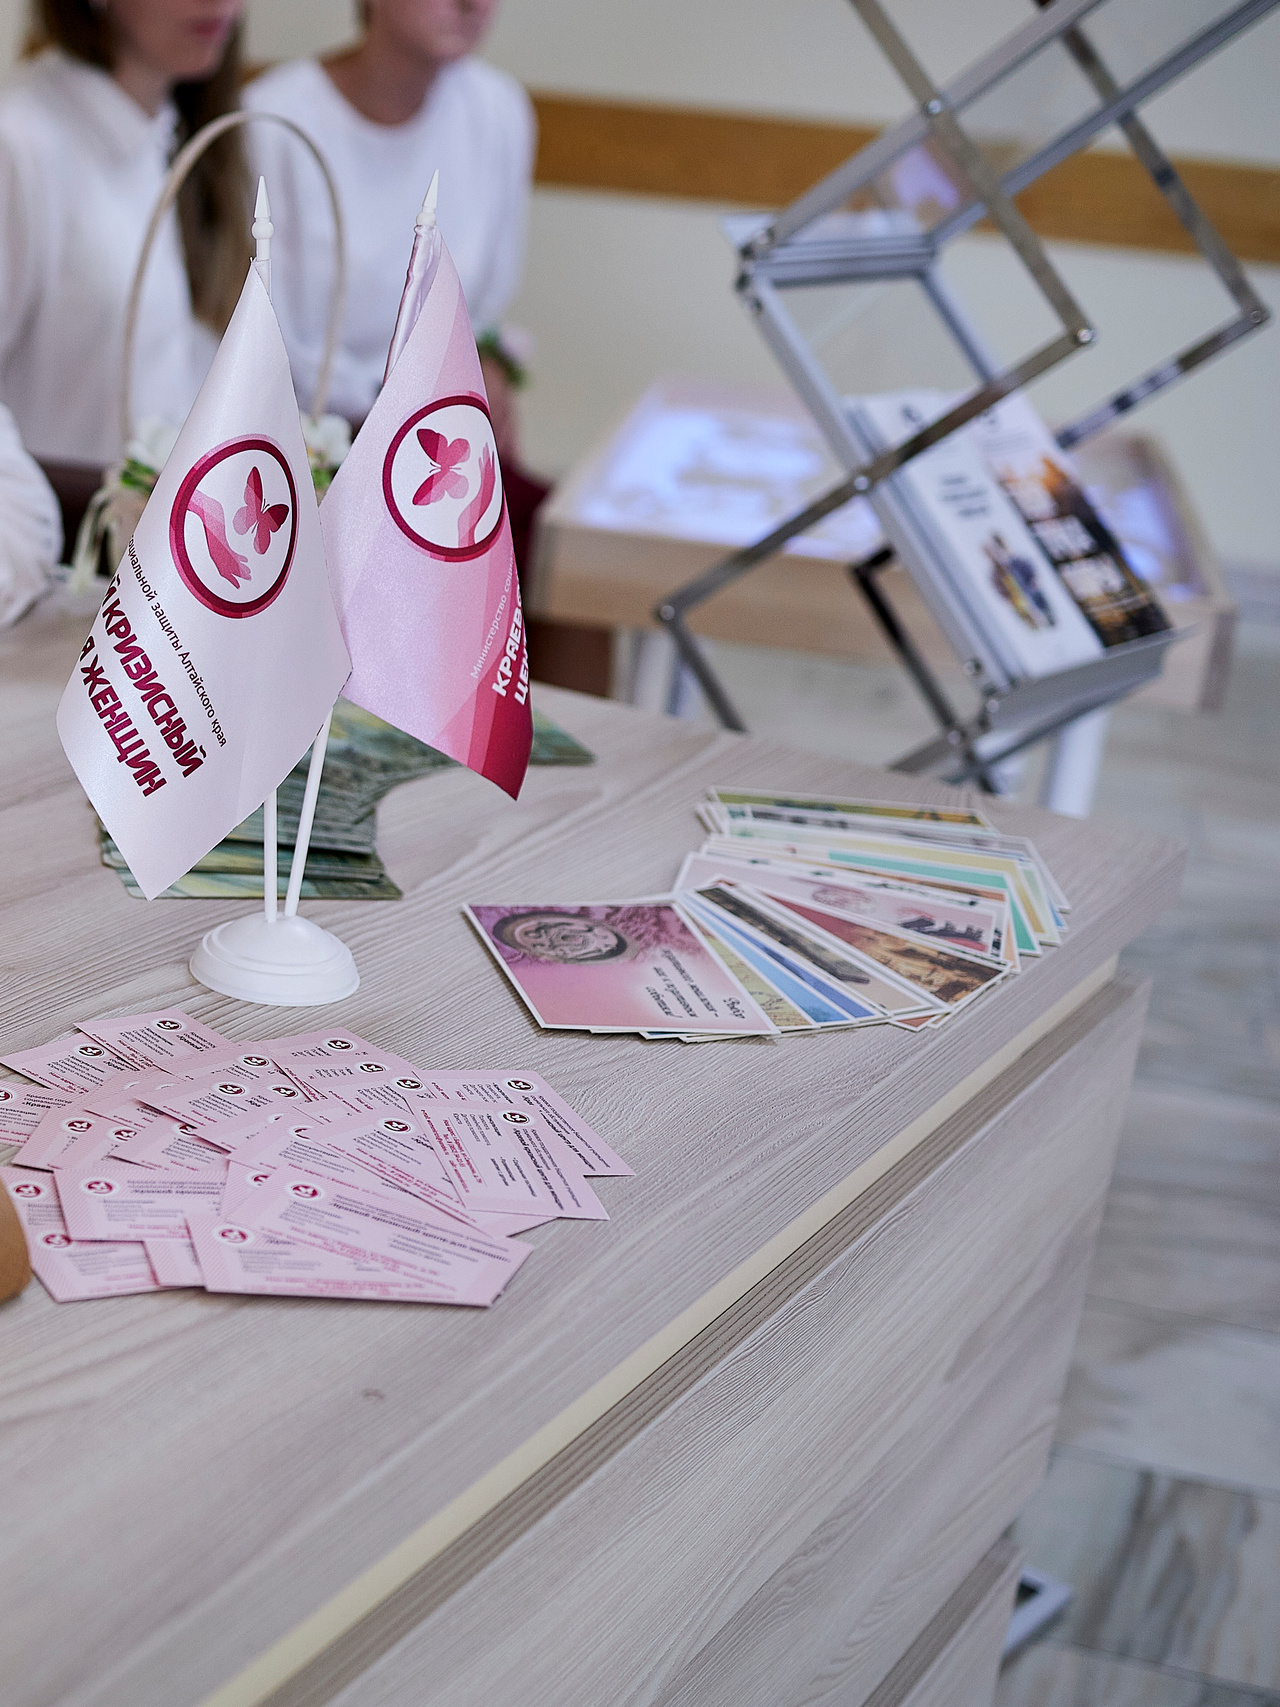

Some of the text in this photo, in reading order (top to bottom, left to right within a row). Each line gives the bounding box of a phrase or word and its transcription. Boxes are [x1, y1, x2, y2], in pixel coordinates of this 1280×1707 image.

[102, 597, 207, 778] КРИЗИСНЫЙ
[128, 534, 227, 748] оциальной защиты Алтайского края
[470, 594, 507, 680] Министерство
[80, 653, 167, 797] ЖЕНЩИН
